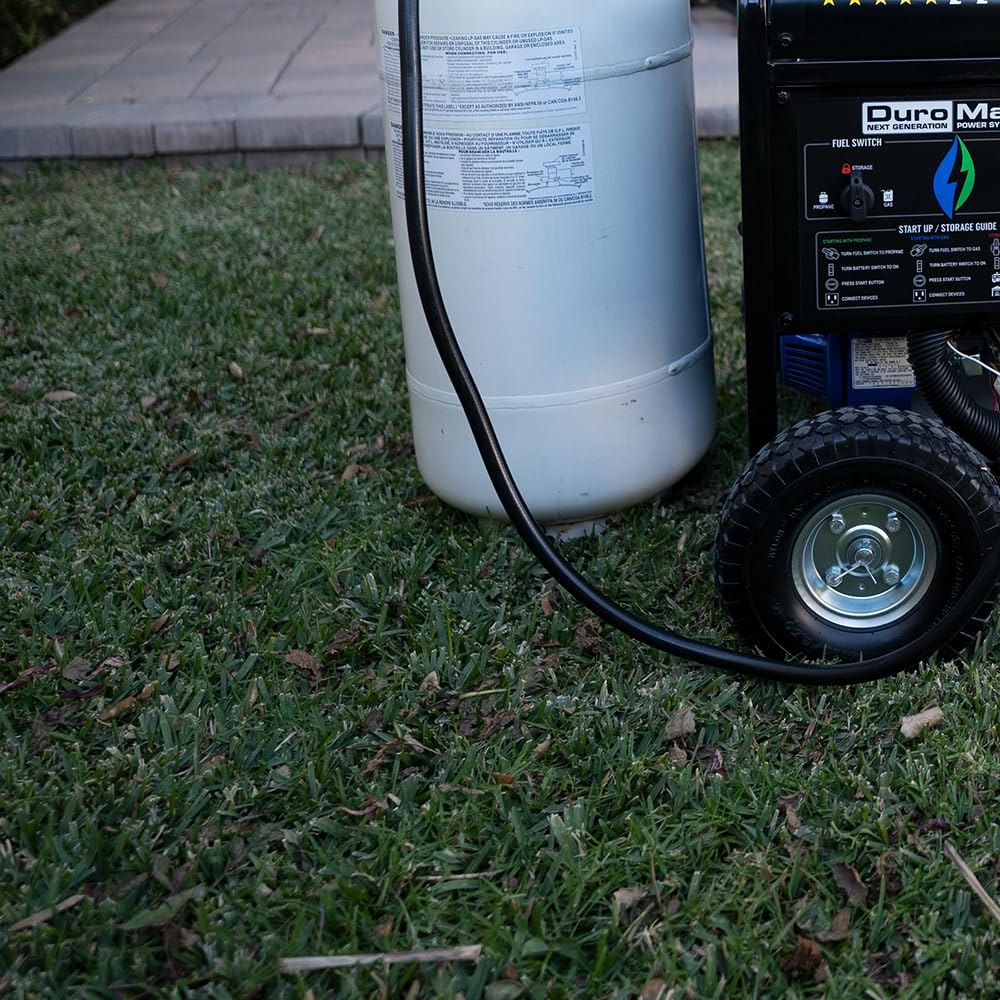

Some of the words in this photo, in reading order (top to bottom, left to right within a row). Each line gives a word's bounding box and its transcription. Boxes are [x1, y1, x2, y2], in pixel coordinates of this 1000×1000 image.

[867, 106, 948, 122] Duro
[892, 122, 948, 130] GENERATION
[832, 139, 849, 148] FUEL
[852, 138, 882, 147] SWITCH
[899, 225, 921, 234] START
[923, 224, 933, 233] UP
[941, 223, 974, 232] STORAGE
[975, 222, 997, 231] GUIDE
